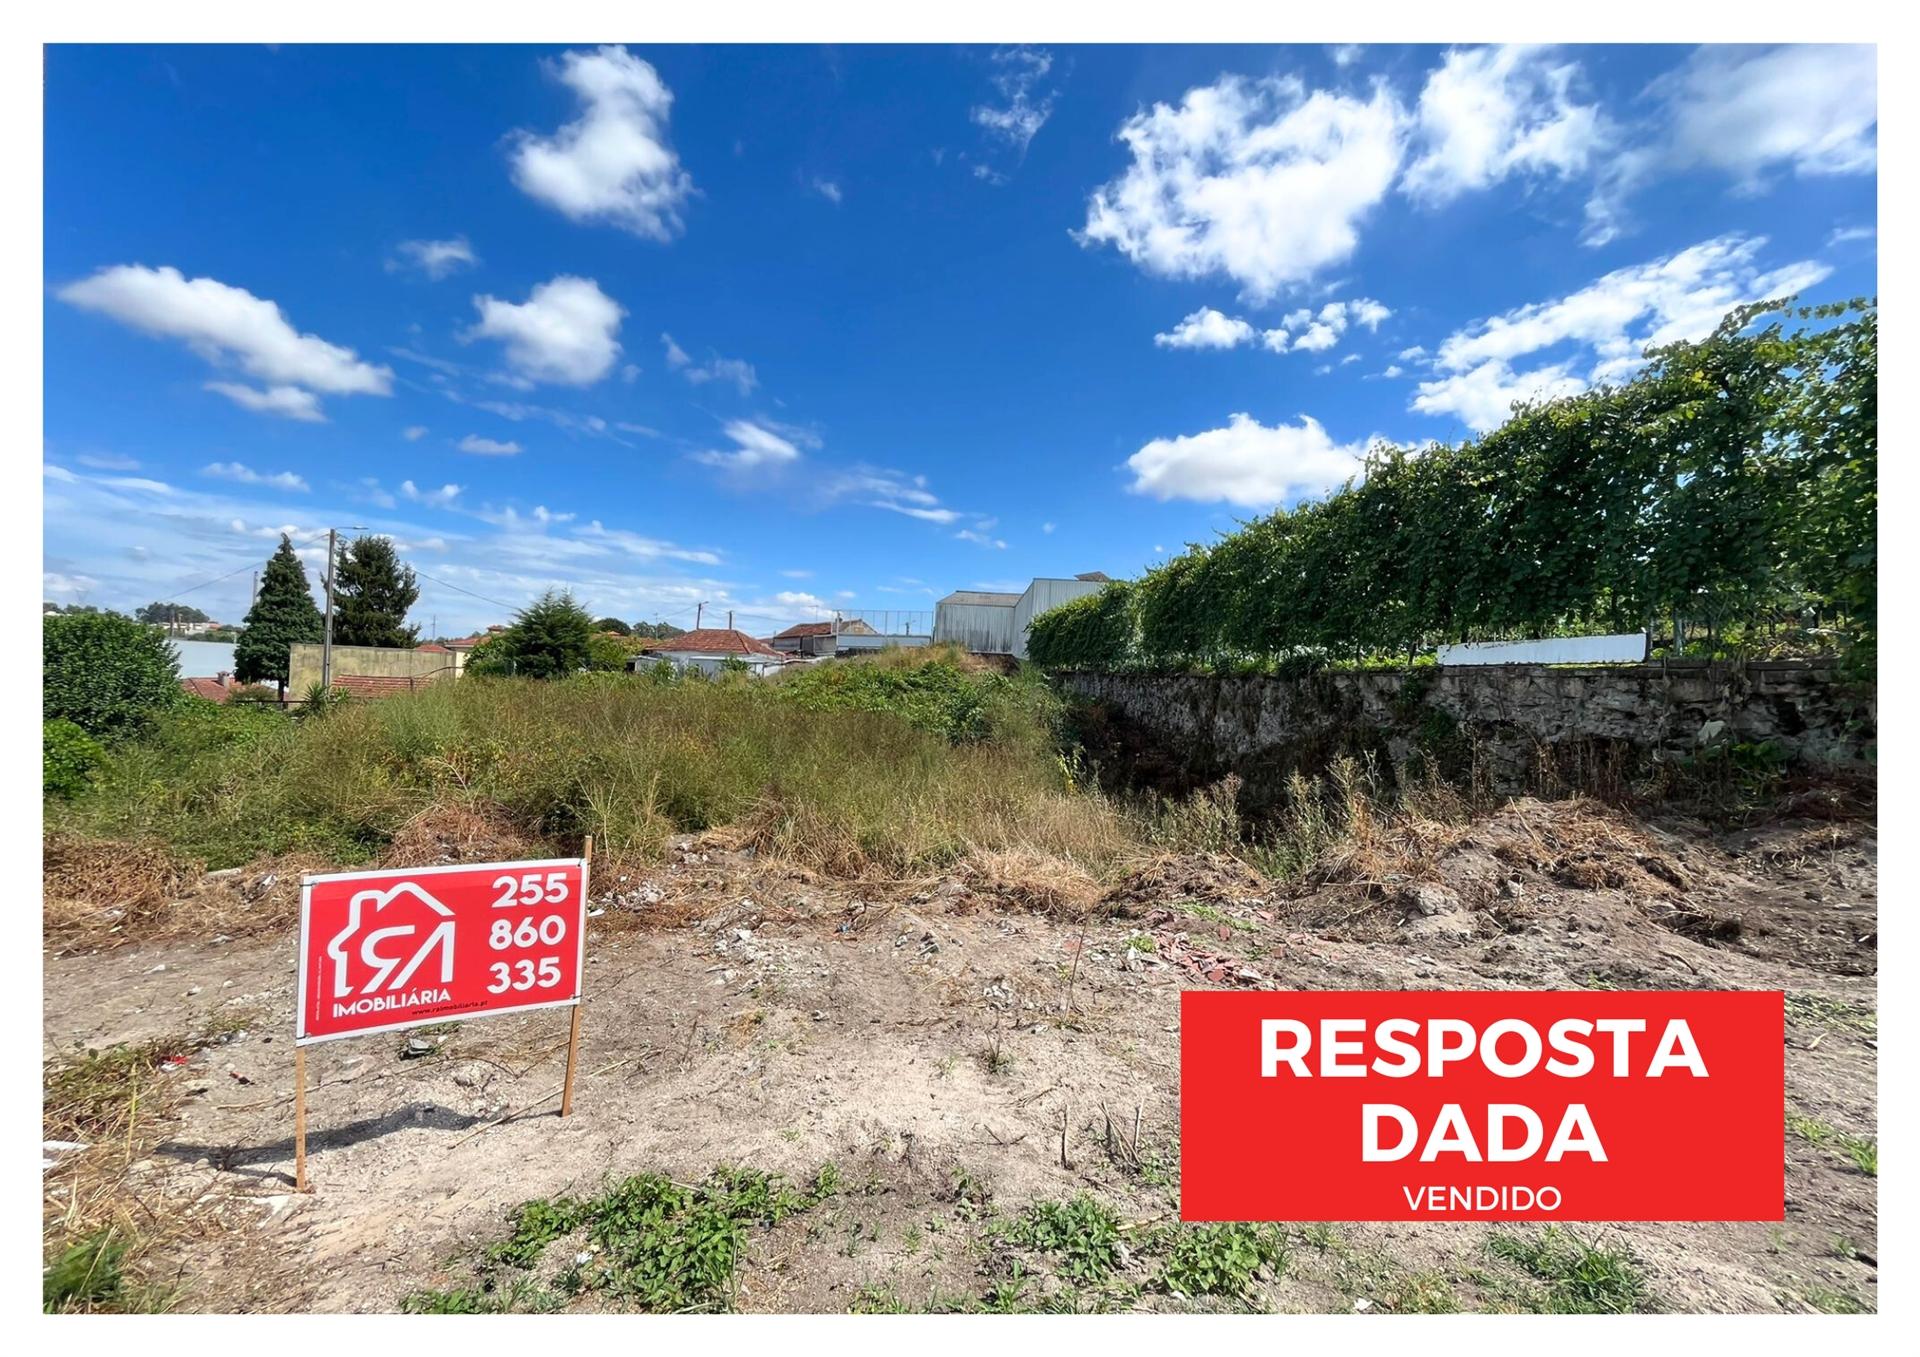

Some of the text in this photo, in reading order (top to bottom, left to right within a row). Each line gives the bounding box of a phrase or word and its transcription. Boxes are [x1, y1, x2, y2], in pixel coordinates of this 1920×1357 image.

[491, 872, 569, 908] 255
[488, 915, 567, 951] 860
[486, 956, 562, 995] 335
[332, 988, 452, 1018] IMOBILIÁRIA
